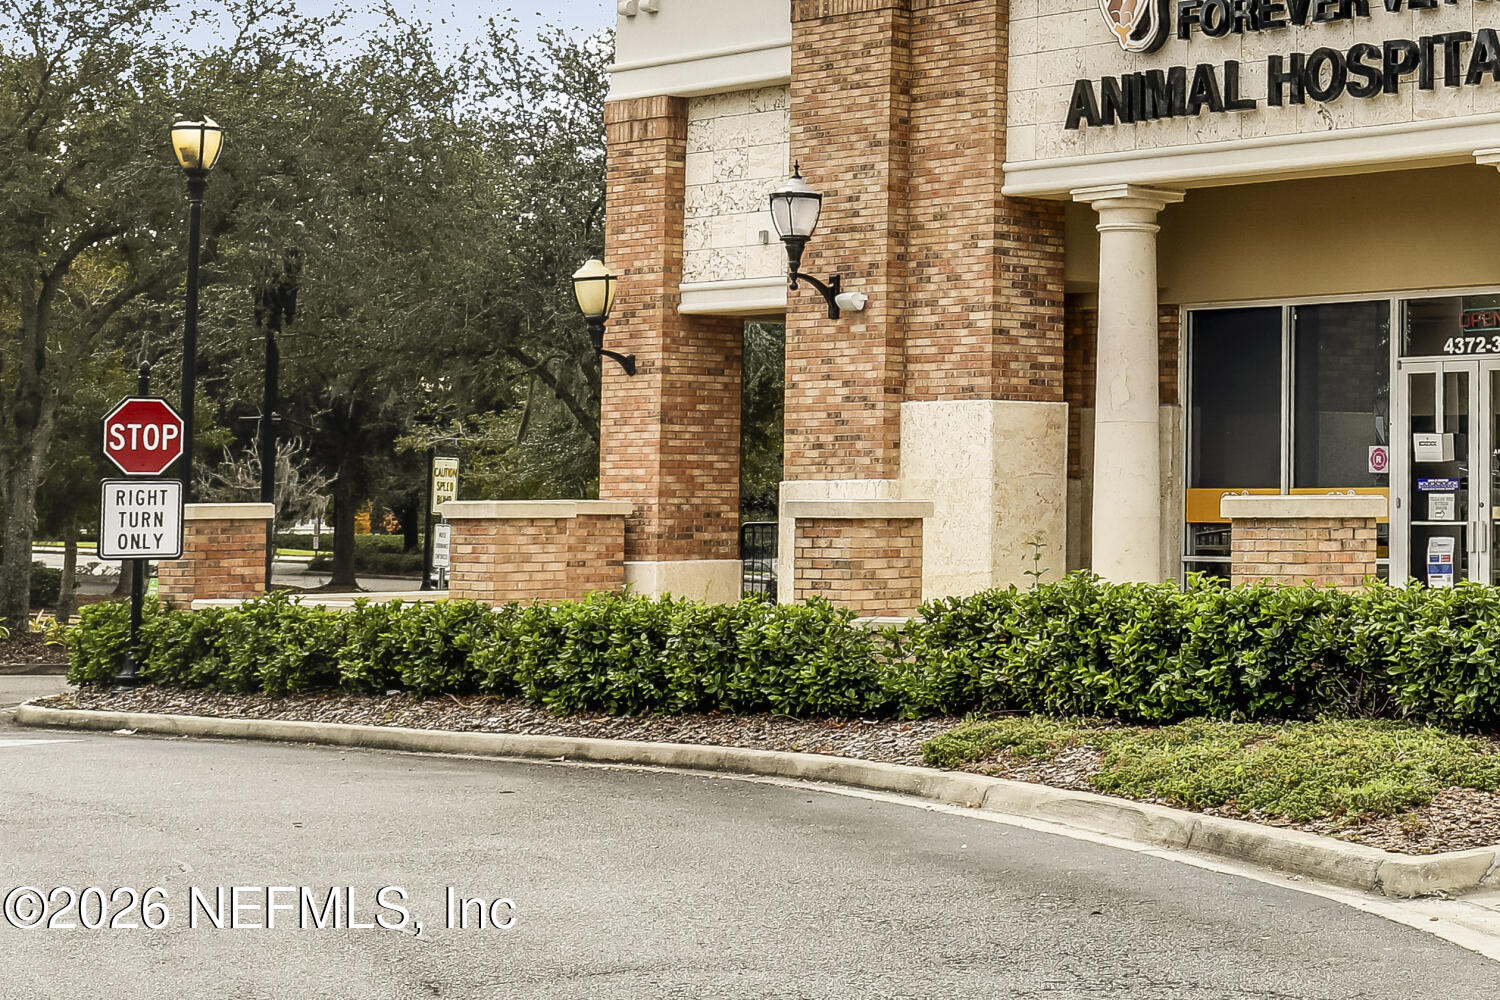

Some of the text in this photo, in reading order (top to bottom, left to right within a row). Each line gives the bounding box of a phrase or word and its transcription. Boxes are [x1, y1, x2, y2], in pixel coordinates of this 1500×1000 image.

[1064, 60, 1257, 130] ANIMAL
[109, 423, 178, 450] STOP
[433, 467, 457, 478] CAUTION
[436, 481, 454, 492] SPEED
[116, 490, 168, 506] RIGHT
[118, 511, 163, 528] TURN
[117, 533, 163, 550] ONLY
